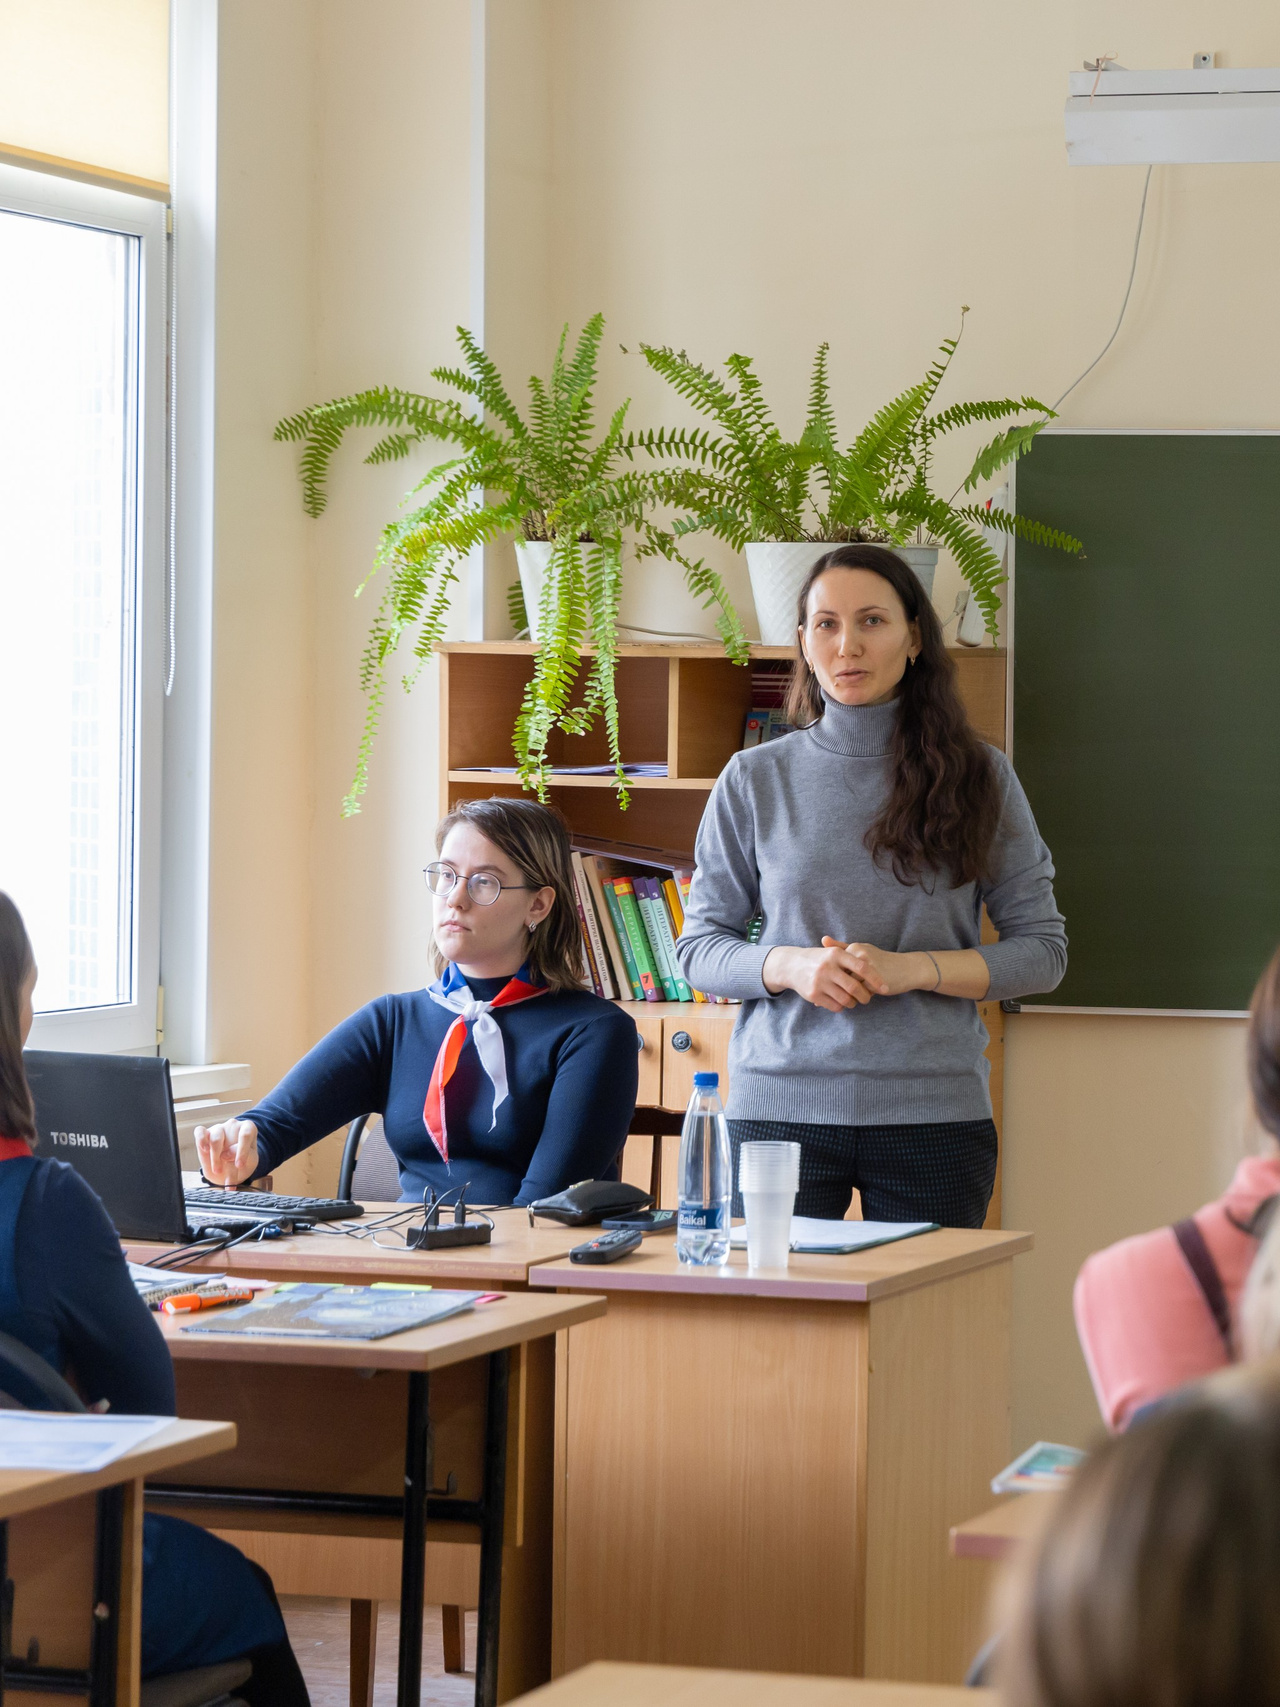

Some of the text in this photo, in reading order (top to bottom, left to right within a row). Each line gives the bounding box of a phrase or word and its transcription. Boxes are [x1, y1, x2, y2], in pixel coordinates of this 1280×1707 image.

[623, 899, 641, 952] ЛИТЕРАТУРА
[640, 903, 661, 953] ЛИТЕРАТУРА
[654, 904, 674, 954] ЛИТЕРАТУРА
[642, 975, 649, 984] 7
[50, 1131, 109, 1149] TOSHIBA
[680, 1213, 706, 1226] Baikal
